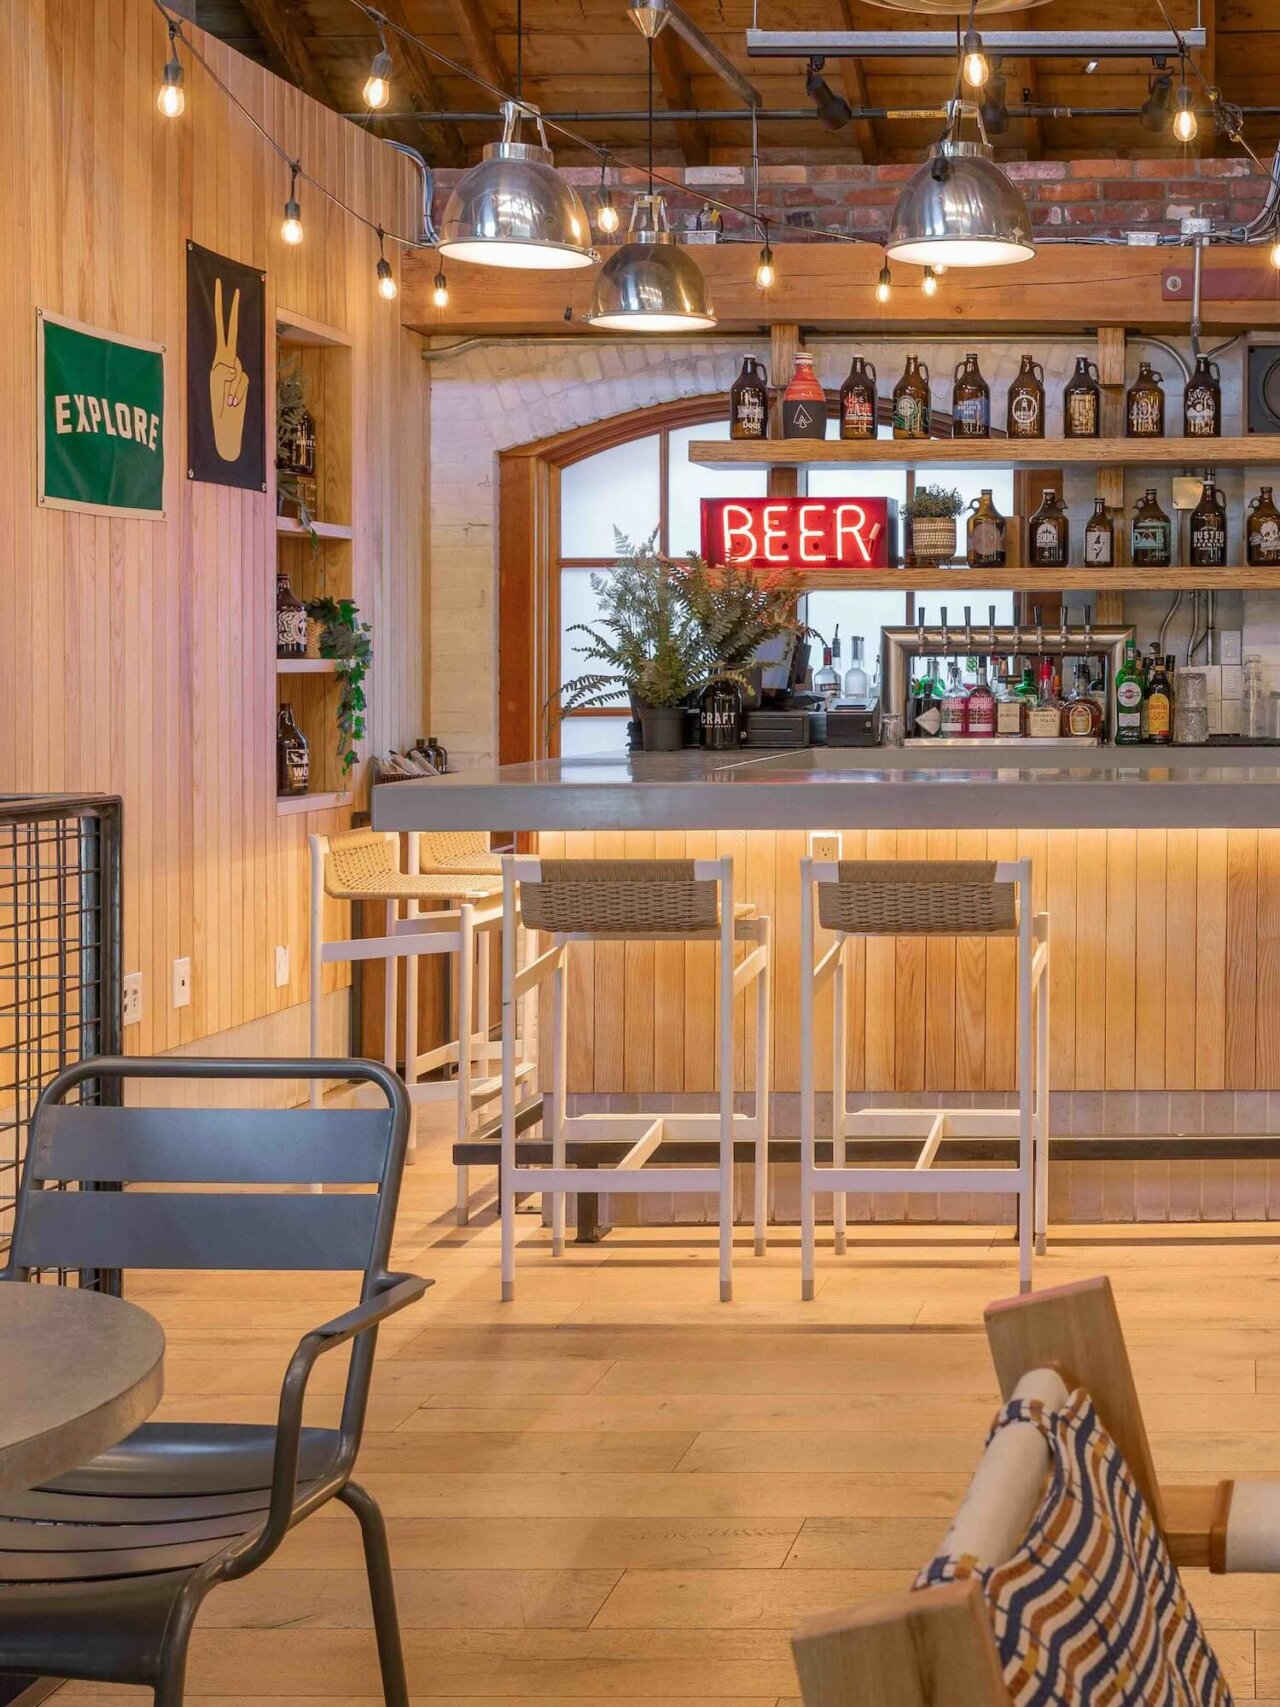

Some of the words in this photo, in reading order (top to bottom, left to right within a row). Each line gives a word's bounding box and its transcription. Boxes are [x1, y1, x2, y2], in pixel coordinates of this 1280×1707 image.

[55, 394, 160, 451] EXPLORE
[723, 504, 871, 562] BEER
[1036, 533, 1058, 543] SOOKE
[701, 712, 736, 725] CRAFT
[293, 767, 308, 776] WO
